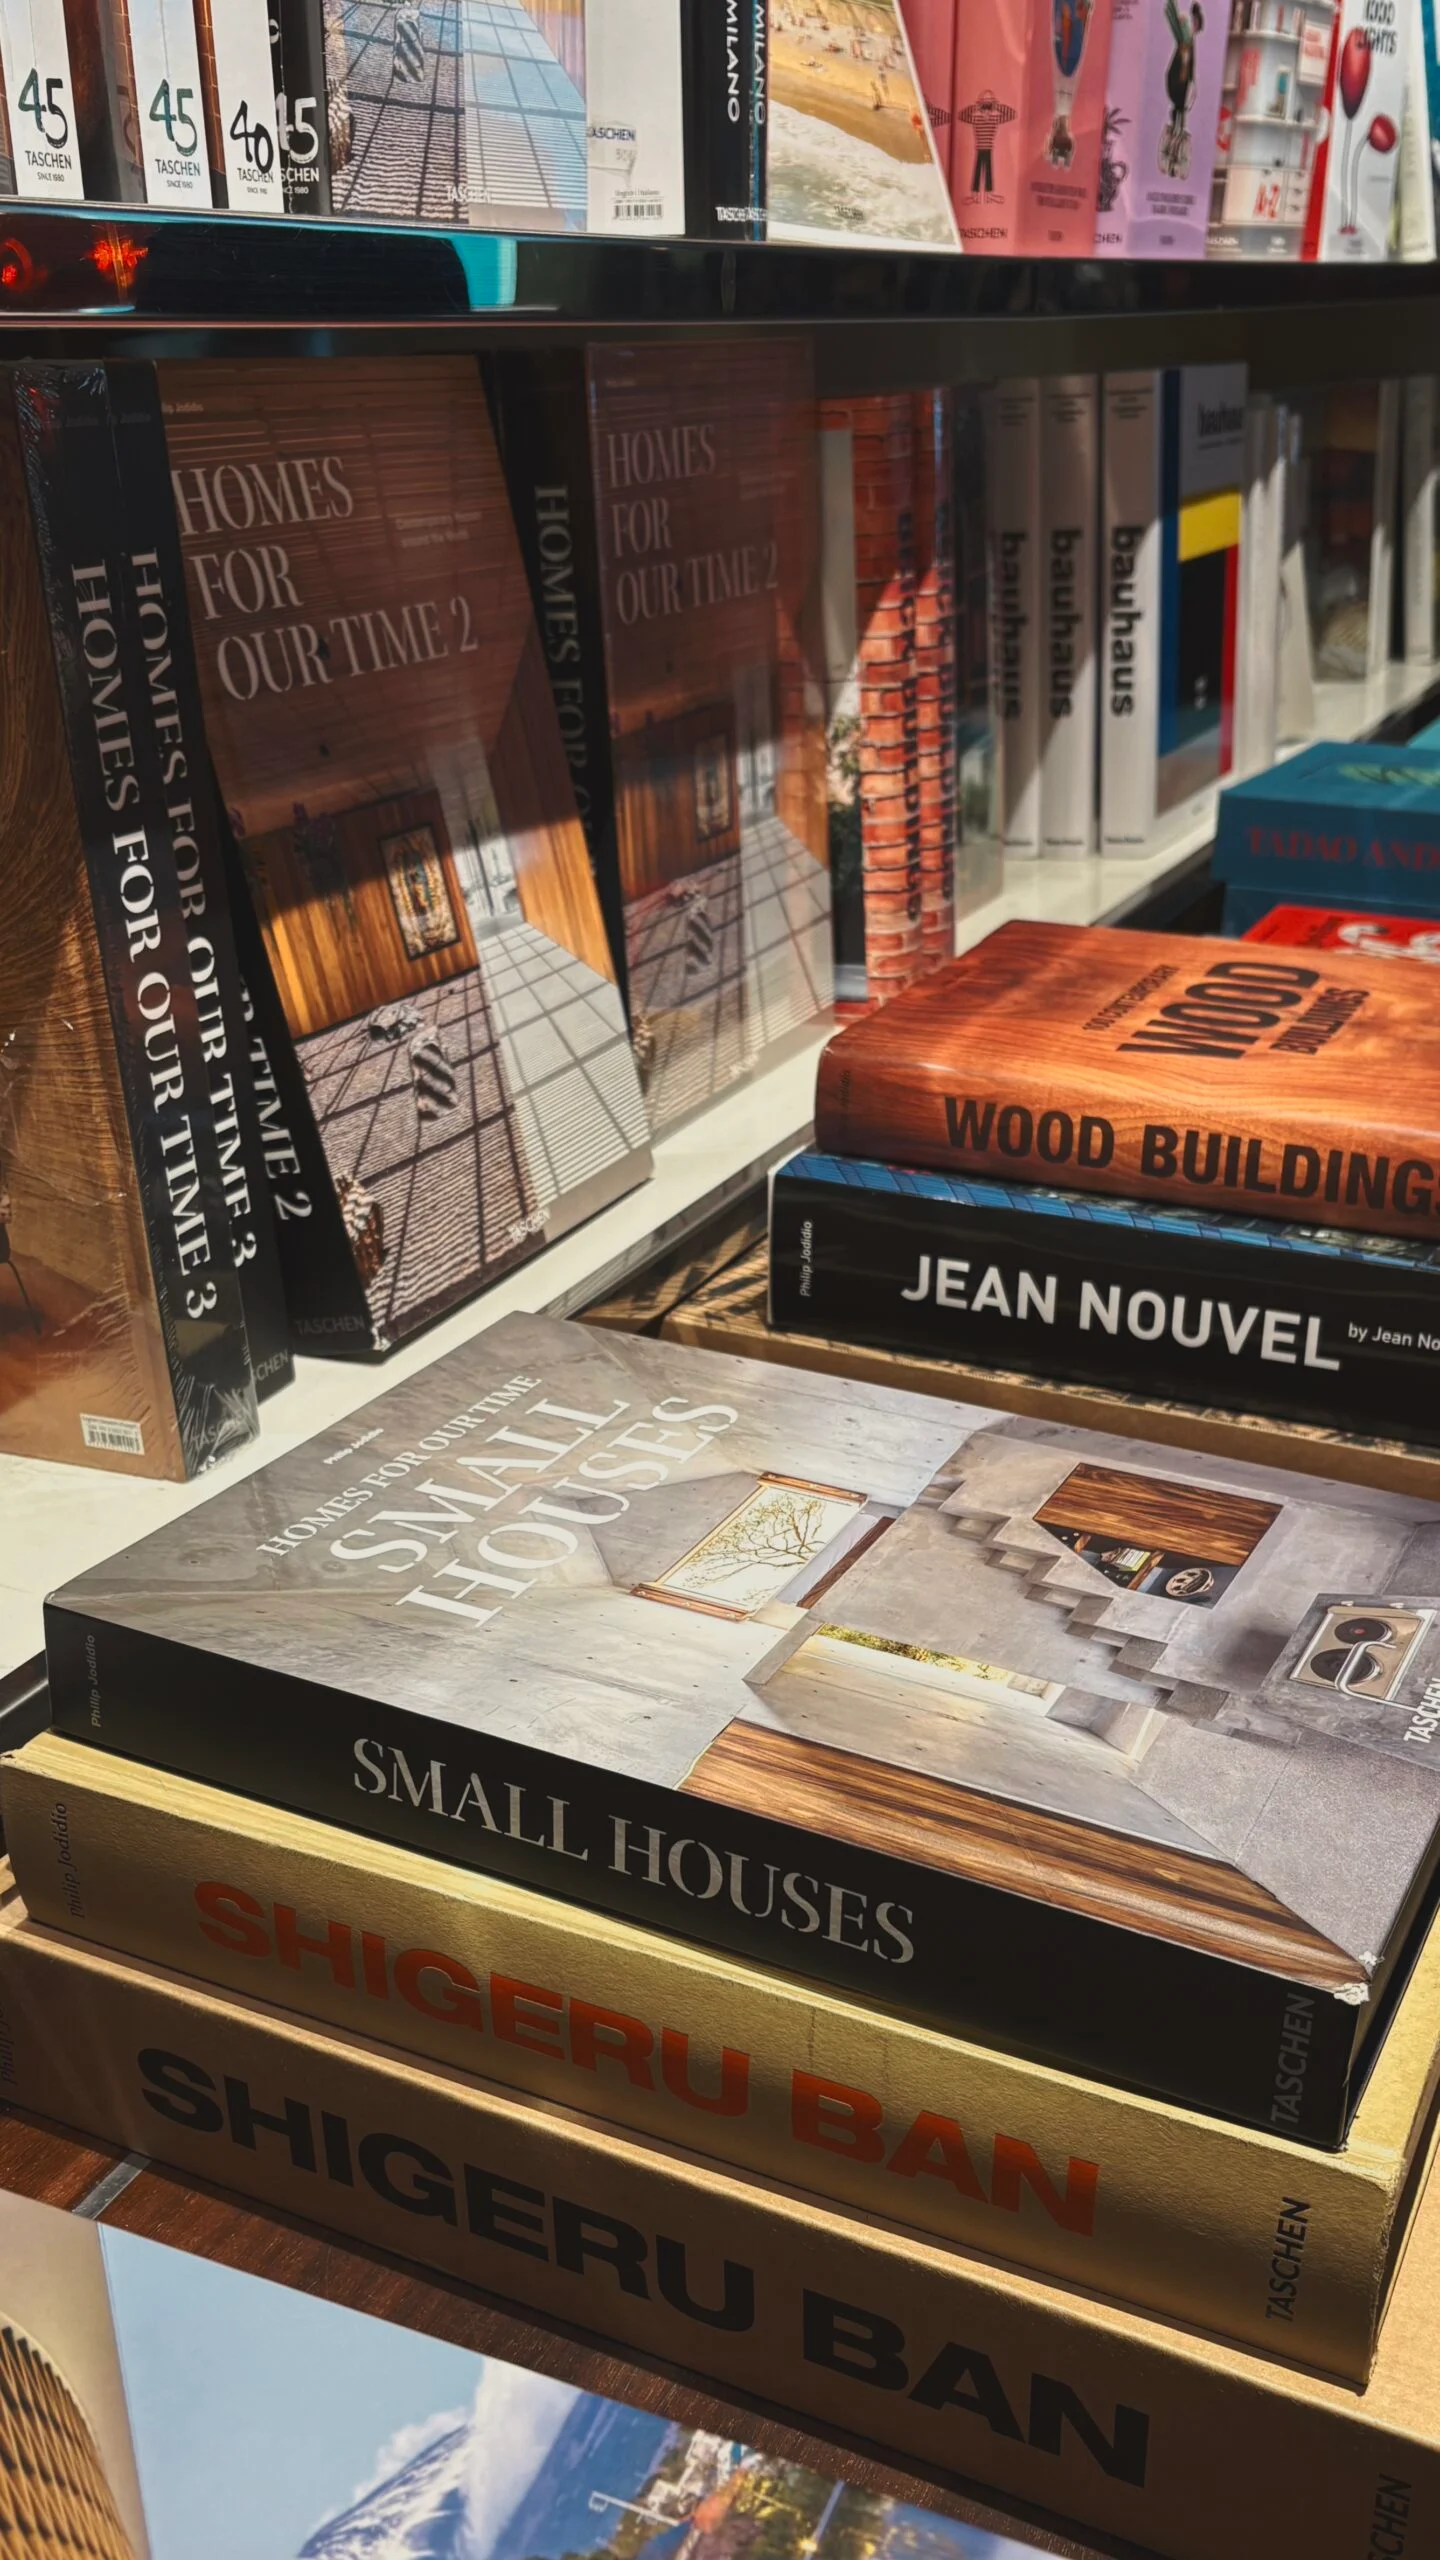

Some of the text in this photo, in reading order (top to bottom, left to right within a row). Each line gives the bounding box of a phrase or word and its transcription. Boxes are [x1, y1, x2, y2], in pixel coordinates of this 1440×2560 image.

[18, 67, 69, 149] 45
[726, 0, 740, 122] MILANO
[24, 149, 73, 170] TASCHEN
[149, 78, 198, 156] 45
[230, 100, 274, 174] 40
[588, 127, 636, 141] ASCHEN
[155, 159, 201, 177] TASCHEN
[237, 167, 274, 183] TASCHEN
[280, 167, 320, 182] SCHEN
[169, 456, 354, 536] HOMES
[607, 424, 716, 489] HOMES
[534, 484, 581, 664] HOMES
[611, 497, 672, 558] FOR
[189, 545, 304, 620] FOR
[615, 543, 779, 626] OUR TIME 2
[1001, 529, 1029, 721] bauhaus
[1049, 527, 1083, 721] bauhaus
[1111, 524, 1146, 718] bauhaus
[216, 597, 480, 701] OUR TIME 2
[1245, 824, 1358, 864] TADAO
[71, 558, 218, 1320] HOMES FOR OUR TIME 3
[130, 546, 258, 1268] HOMES FOR OUR TIME 3
[1116, 961, 1320, 1060] WOOD
[1269, 987, 1371, 1055] BUILDINGS
[249, 1037, 313, 1221] TIME 2
[943, 1095, 1440, 1219] WOOD BUILDING
[800, 1220, 813, 1298] Philip Jodidio
[294, 1315, 366, 1335] TASCHEN
[901, 1254, 1440, 1372] JEAN NOUVEL by Jean No
[256, 1373, 543, 1557] HOMES FOR OUR TIME
[329, 1398, 631, 1574] SMALL
[396, 1395, 740, 1629] HOUSES
[84, 1633, 102, 1728] Philip Jodidio
[50, 1802, 86, 1920] Philip Jodidio
[353, 1737, 915, 1965] SMALL HOUSES
[193, 1880, 1100, 2238] SHIGERU BAN
[1269, 1991, 1316, 2124] TASCHEN
[137, 2046, 1150, 2489] SHIGERU BAN
[1264, 2196, 1312, 2325] TASCHEN
[1366, 2473, 1413, 2560] CHEN
